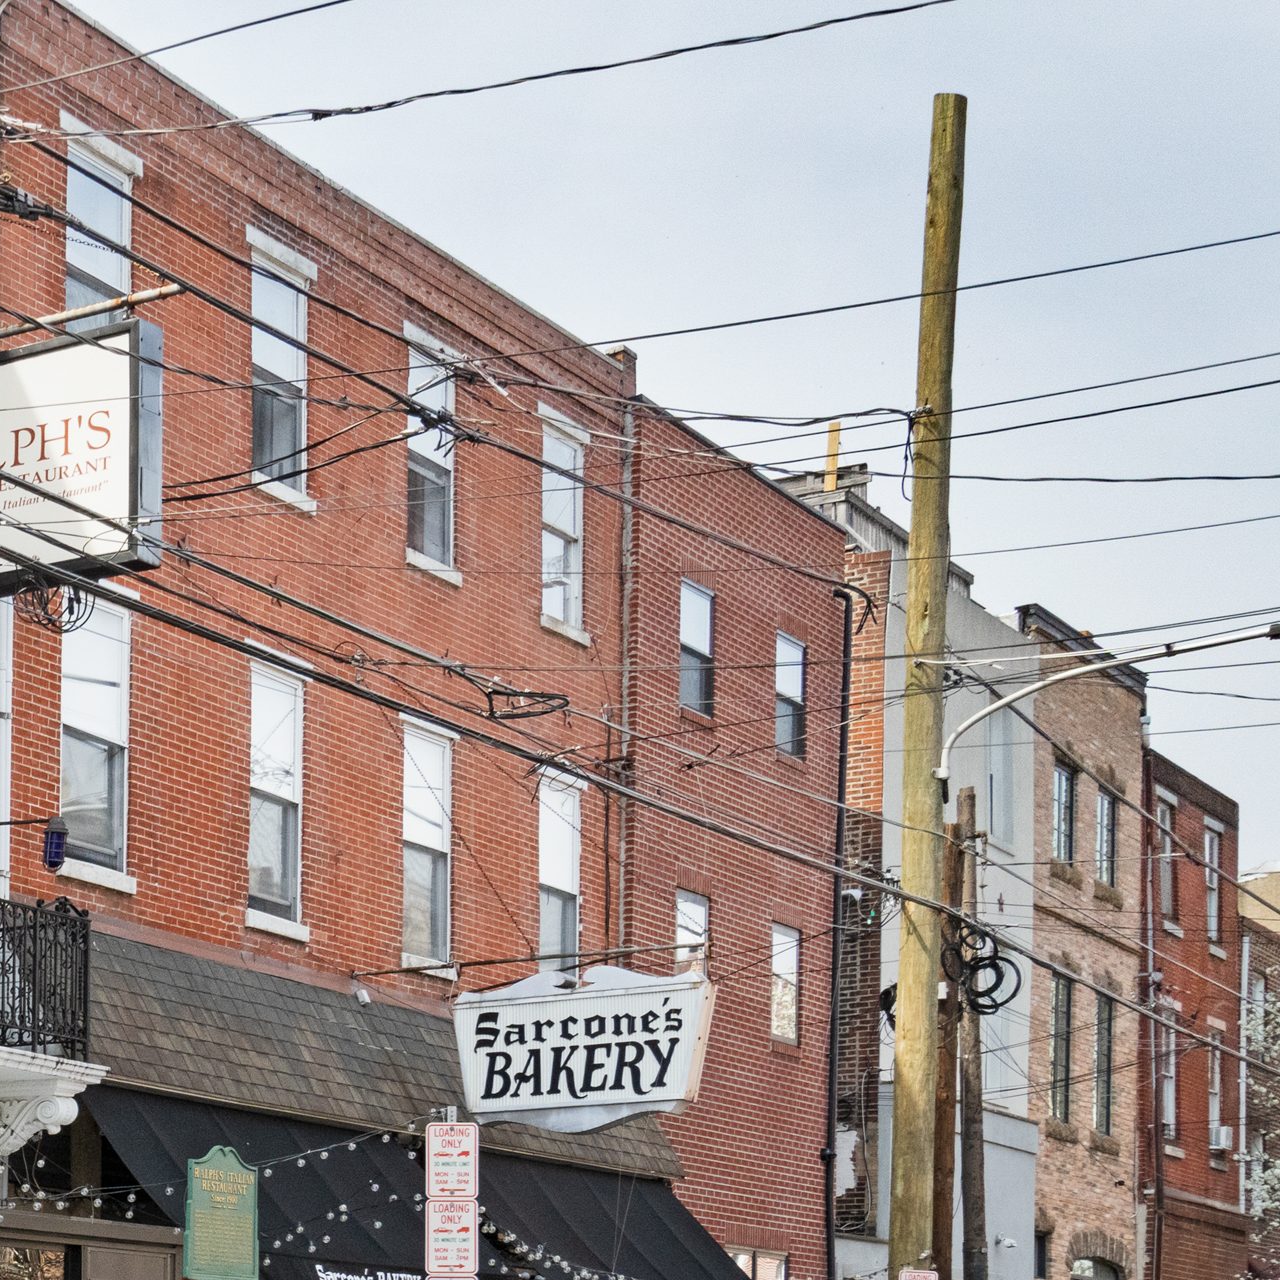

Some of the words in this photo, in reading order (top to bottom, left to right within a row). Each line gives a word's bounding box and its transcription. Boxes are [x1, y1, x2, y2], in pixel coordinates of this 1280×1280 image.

[2, 496, 45, 511] Italian
[474, 997, 683, 1053] Sarcone's
[481, 1037, 680, 1100] BAKERY
[434, 1128, 470, 1137] LOADING
[441, 1139, 462, 1148] ONLY
[226, 1172, 254, 1184] ITALIAN
[202, 1180, 247, 1195] RESTAURANT
[433, 1203, 470, 1213] LOADING
[441, 1215, 462, 1224] ONLY
